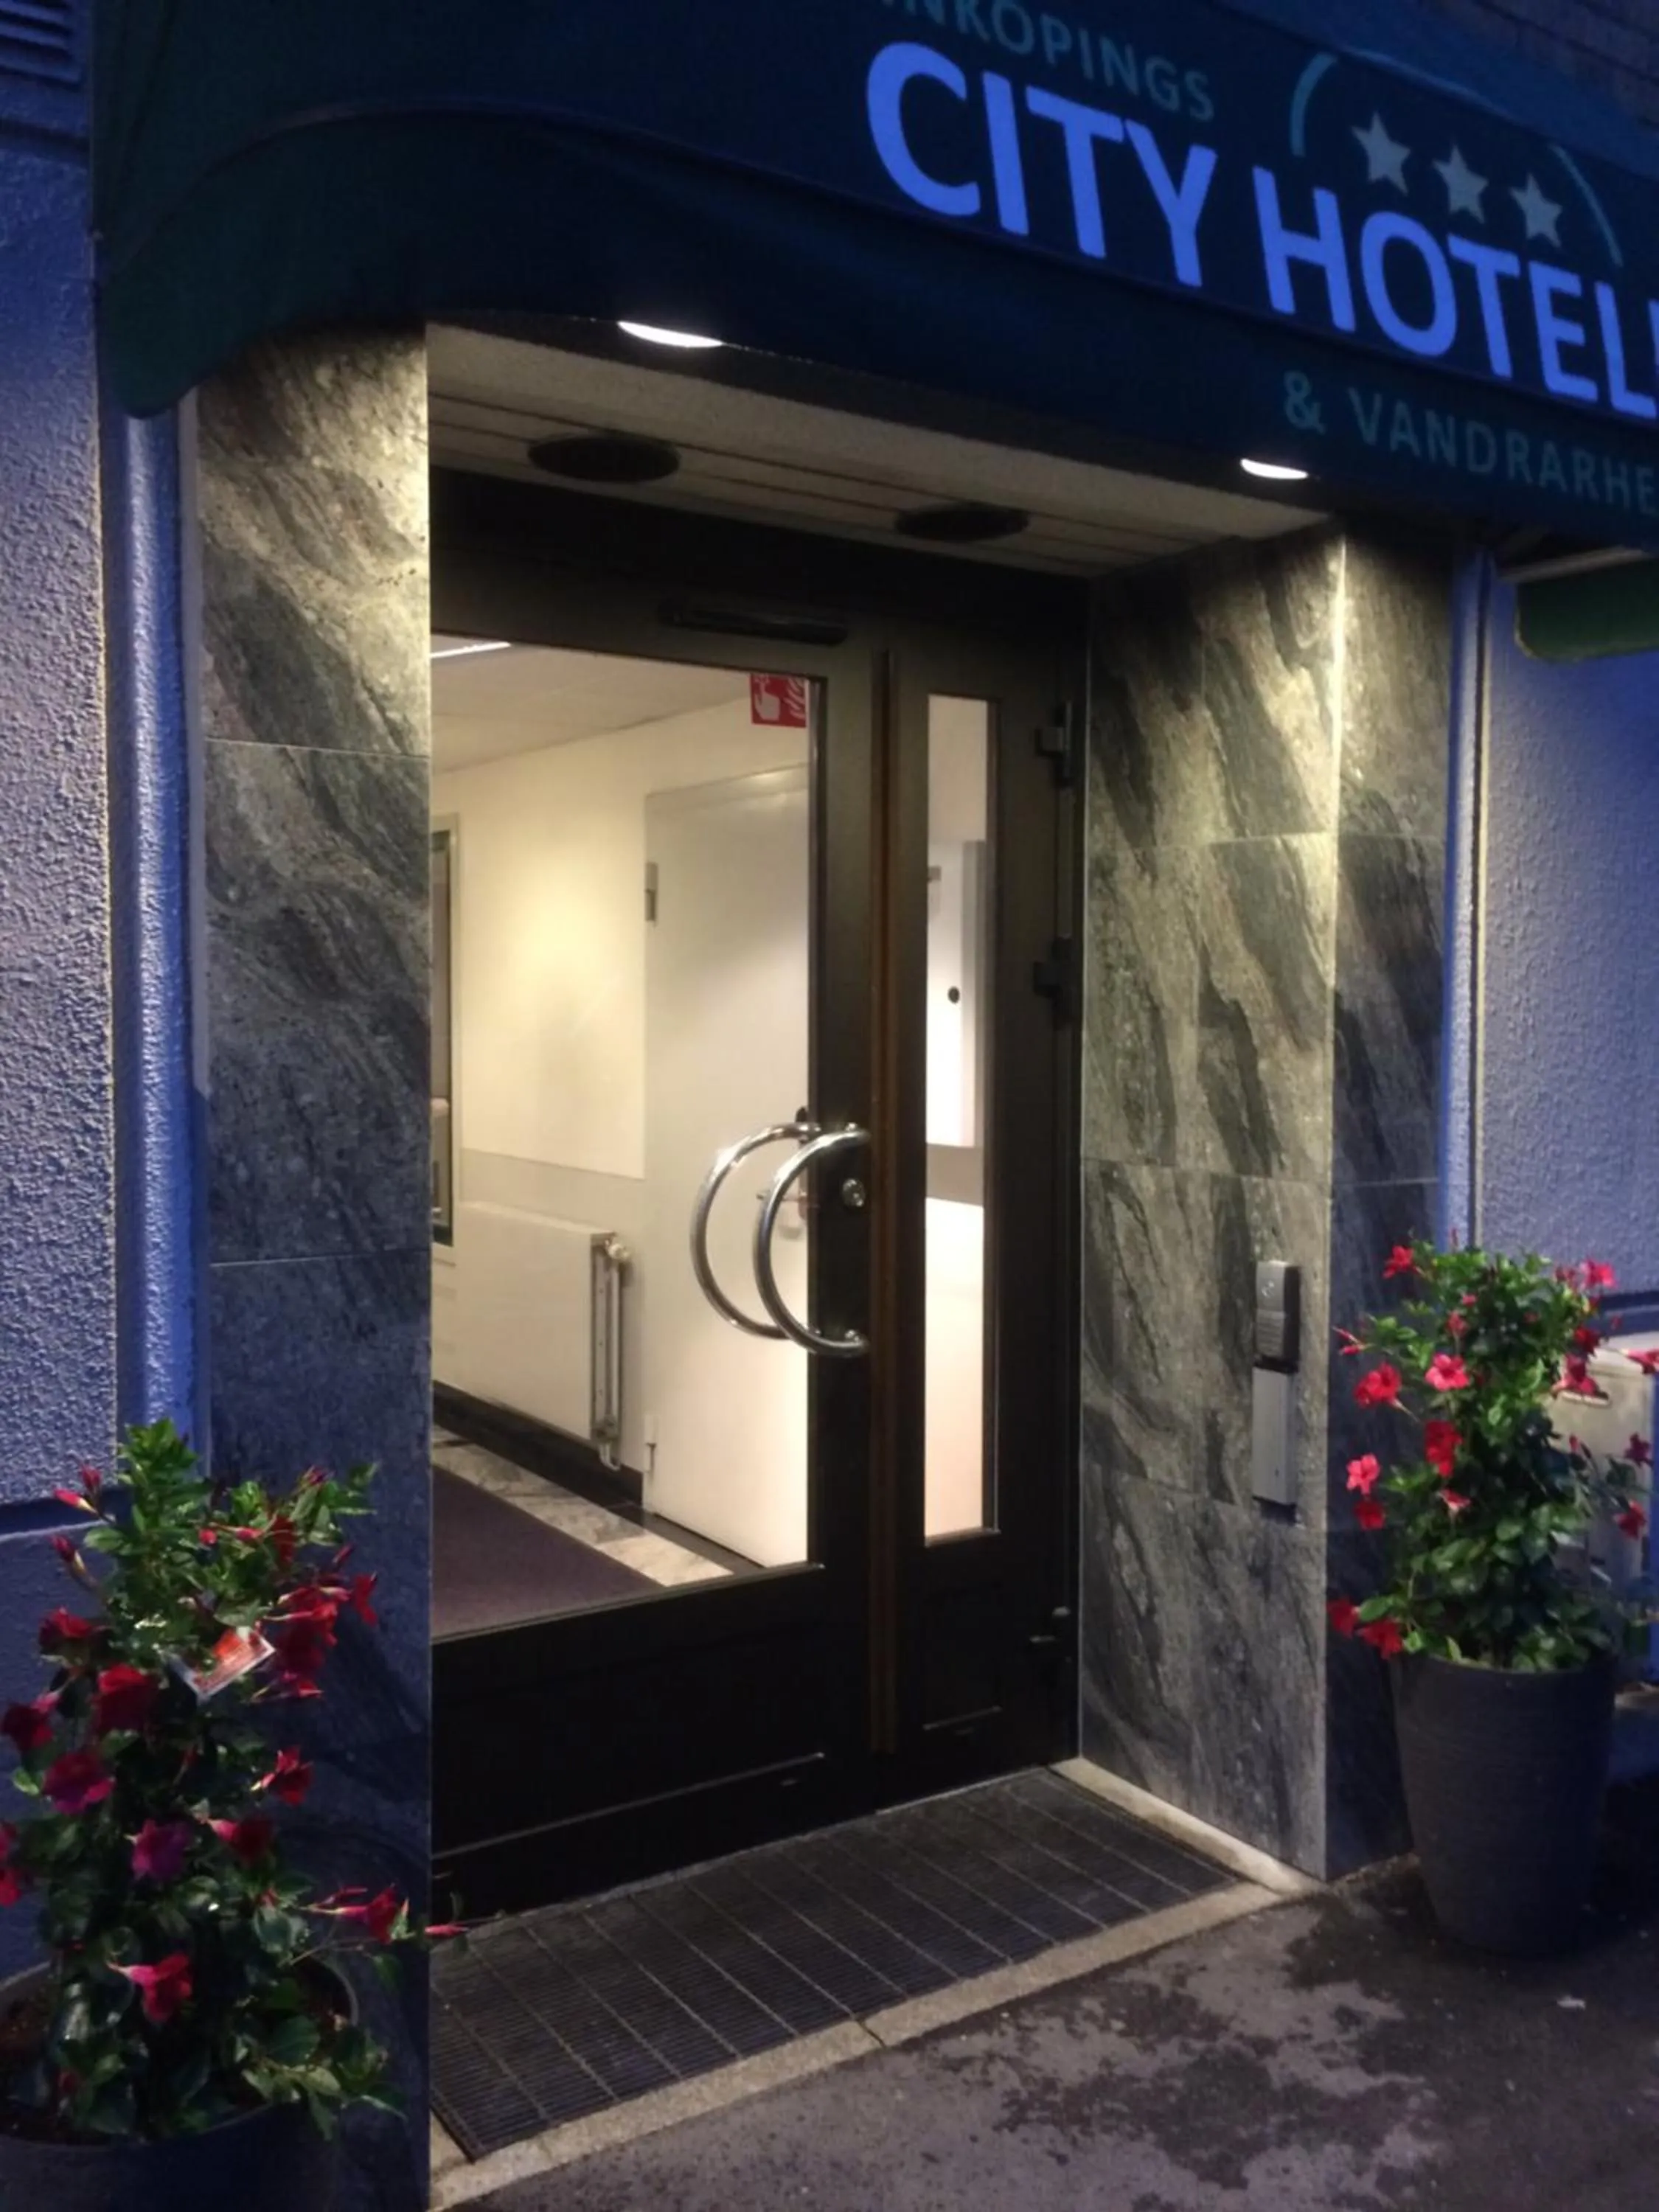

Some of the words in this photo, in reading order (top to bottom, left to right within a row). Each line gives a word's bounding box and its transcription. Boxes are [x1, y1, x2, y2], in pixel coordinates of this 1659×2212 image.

[866, 41, 1218, 288] CITY
[1252, 164, 1659, 420] HOTEL
[1283, 371, 1326, 434] &
